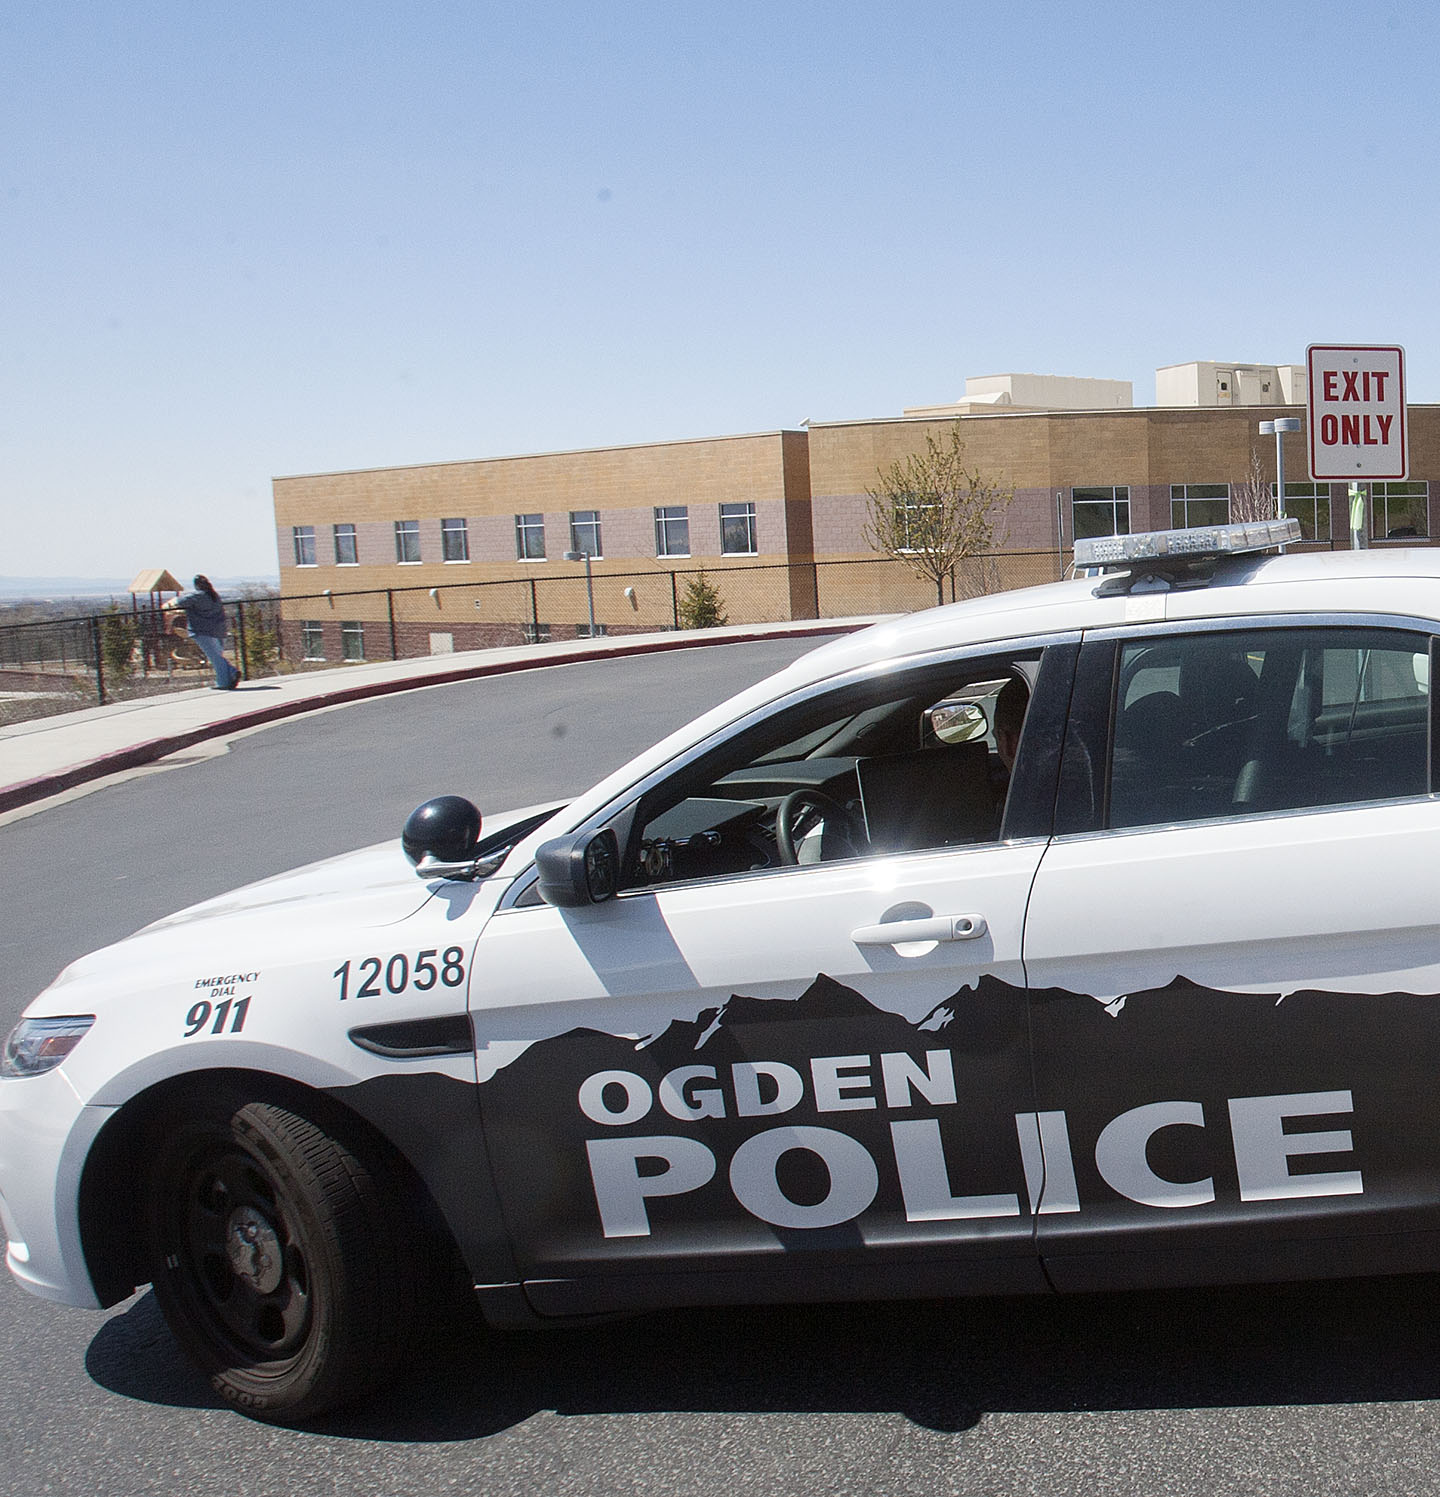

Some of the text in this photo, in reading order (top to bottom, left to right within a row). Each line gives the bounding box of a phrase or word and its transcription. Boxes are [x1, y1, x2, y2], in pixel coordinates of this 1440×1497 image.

[1323, 371, 1389, 402] EXIT
[1321, 414, 1393, 445] ONLY
[195, 972, 260, 989] EMERGENCY
[333, 946, 465, 1001] 12058
[210, 986, 235, 998] DIAL
[184, 996, 252, 1038] 911
[578, 1049, 958, 1126] OGDEN
[585, 1089, 1365, 1238] POLICE
